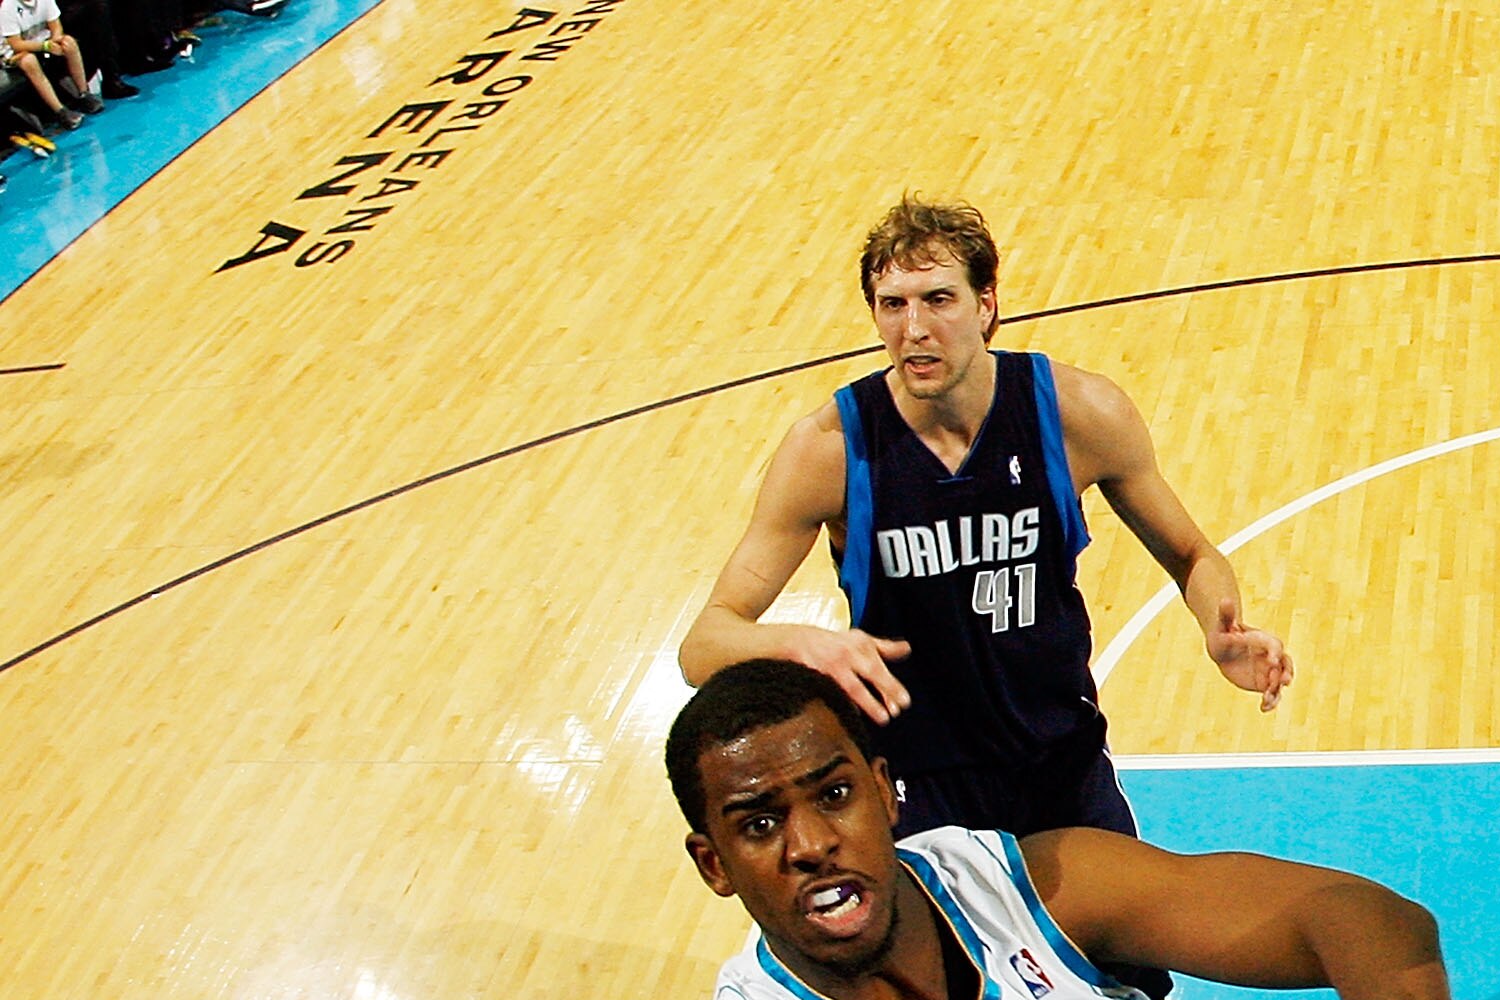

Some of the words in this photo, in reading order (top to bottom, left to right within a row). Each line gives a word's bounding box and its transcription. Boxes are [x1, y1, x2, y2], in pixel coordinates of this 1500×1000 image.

[521, 0, 625, 61] NEW
[212, 7, 558, 274] ARENA
[294, 74, 533, 268] ORLEANS
[876, 506, 1040, 578] DALLAS
[971, 562, 1037, 634] 41
